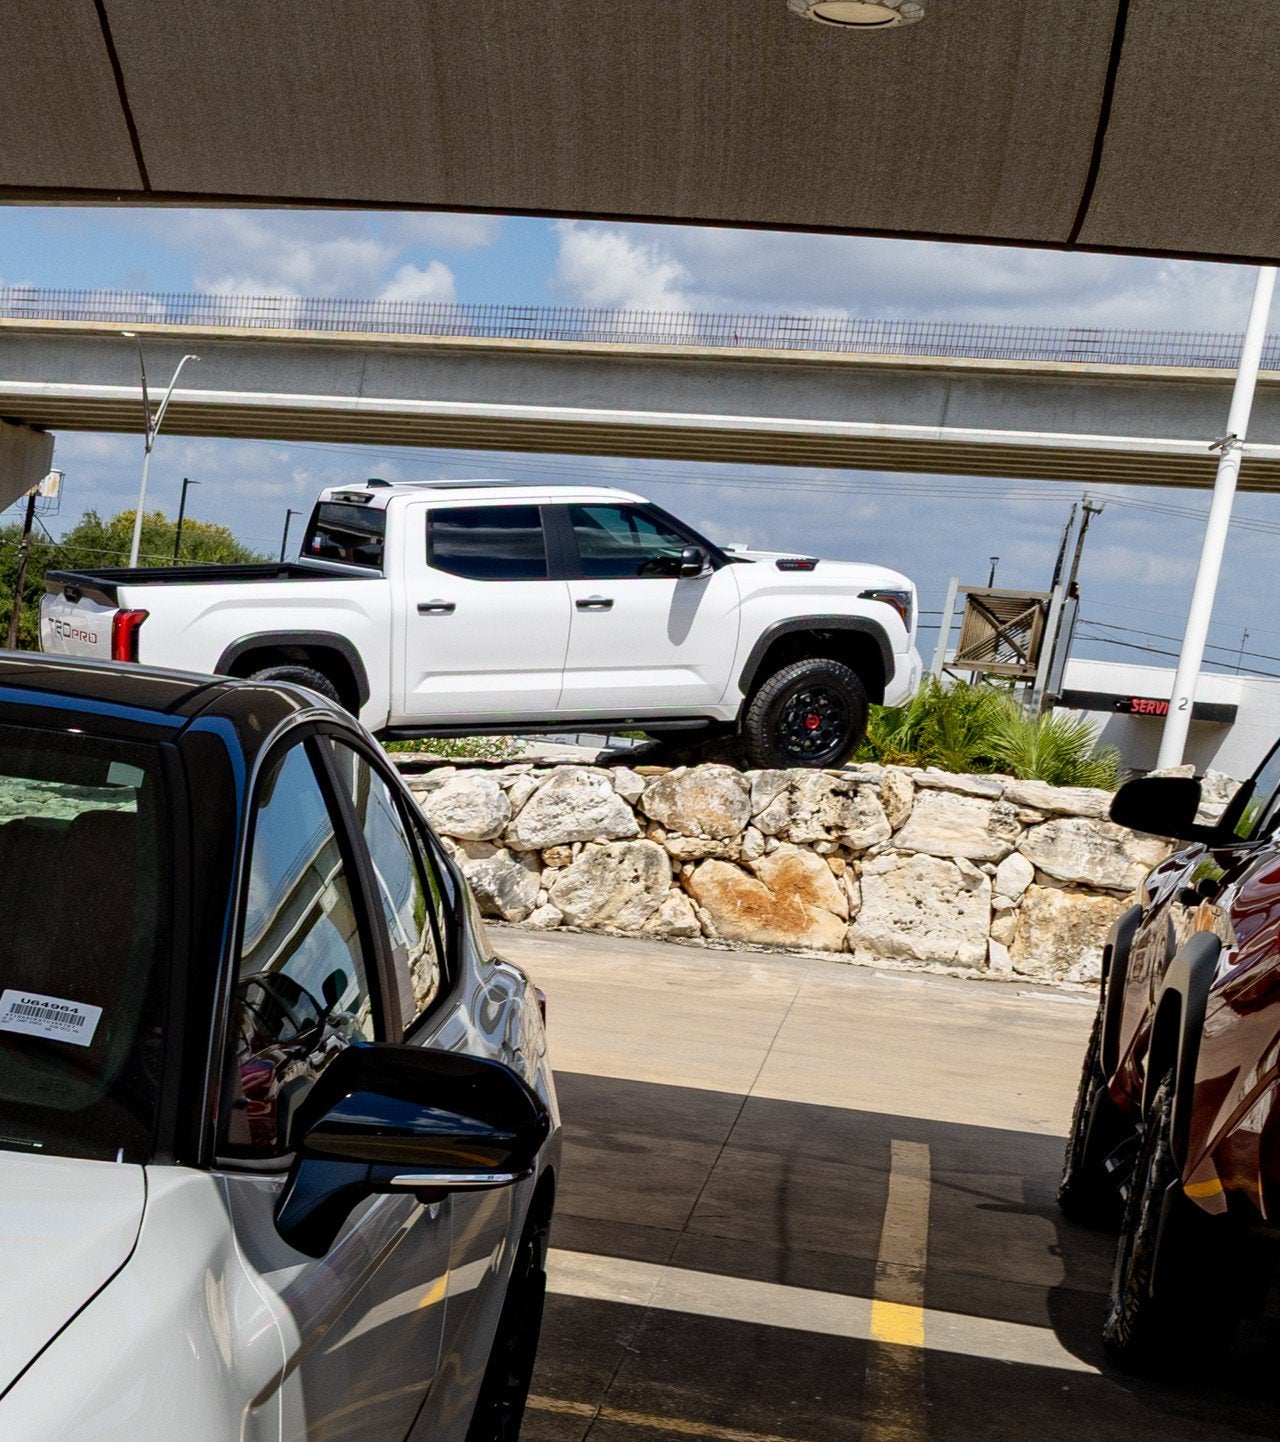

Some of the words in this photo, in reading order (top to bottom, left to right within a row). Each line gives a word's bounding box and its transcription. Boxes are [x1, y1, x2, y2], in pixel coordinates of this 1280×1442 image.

[1130, 698, 1170, 715] SERVI
[1178, 697, 1188, 710] 2
[20, 997, 80, 1014] U64964
